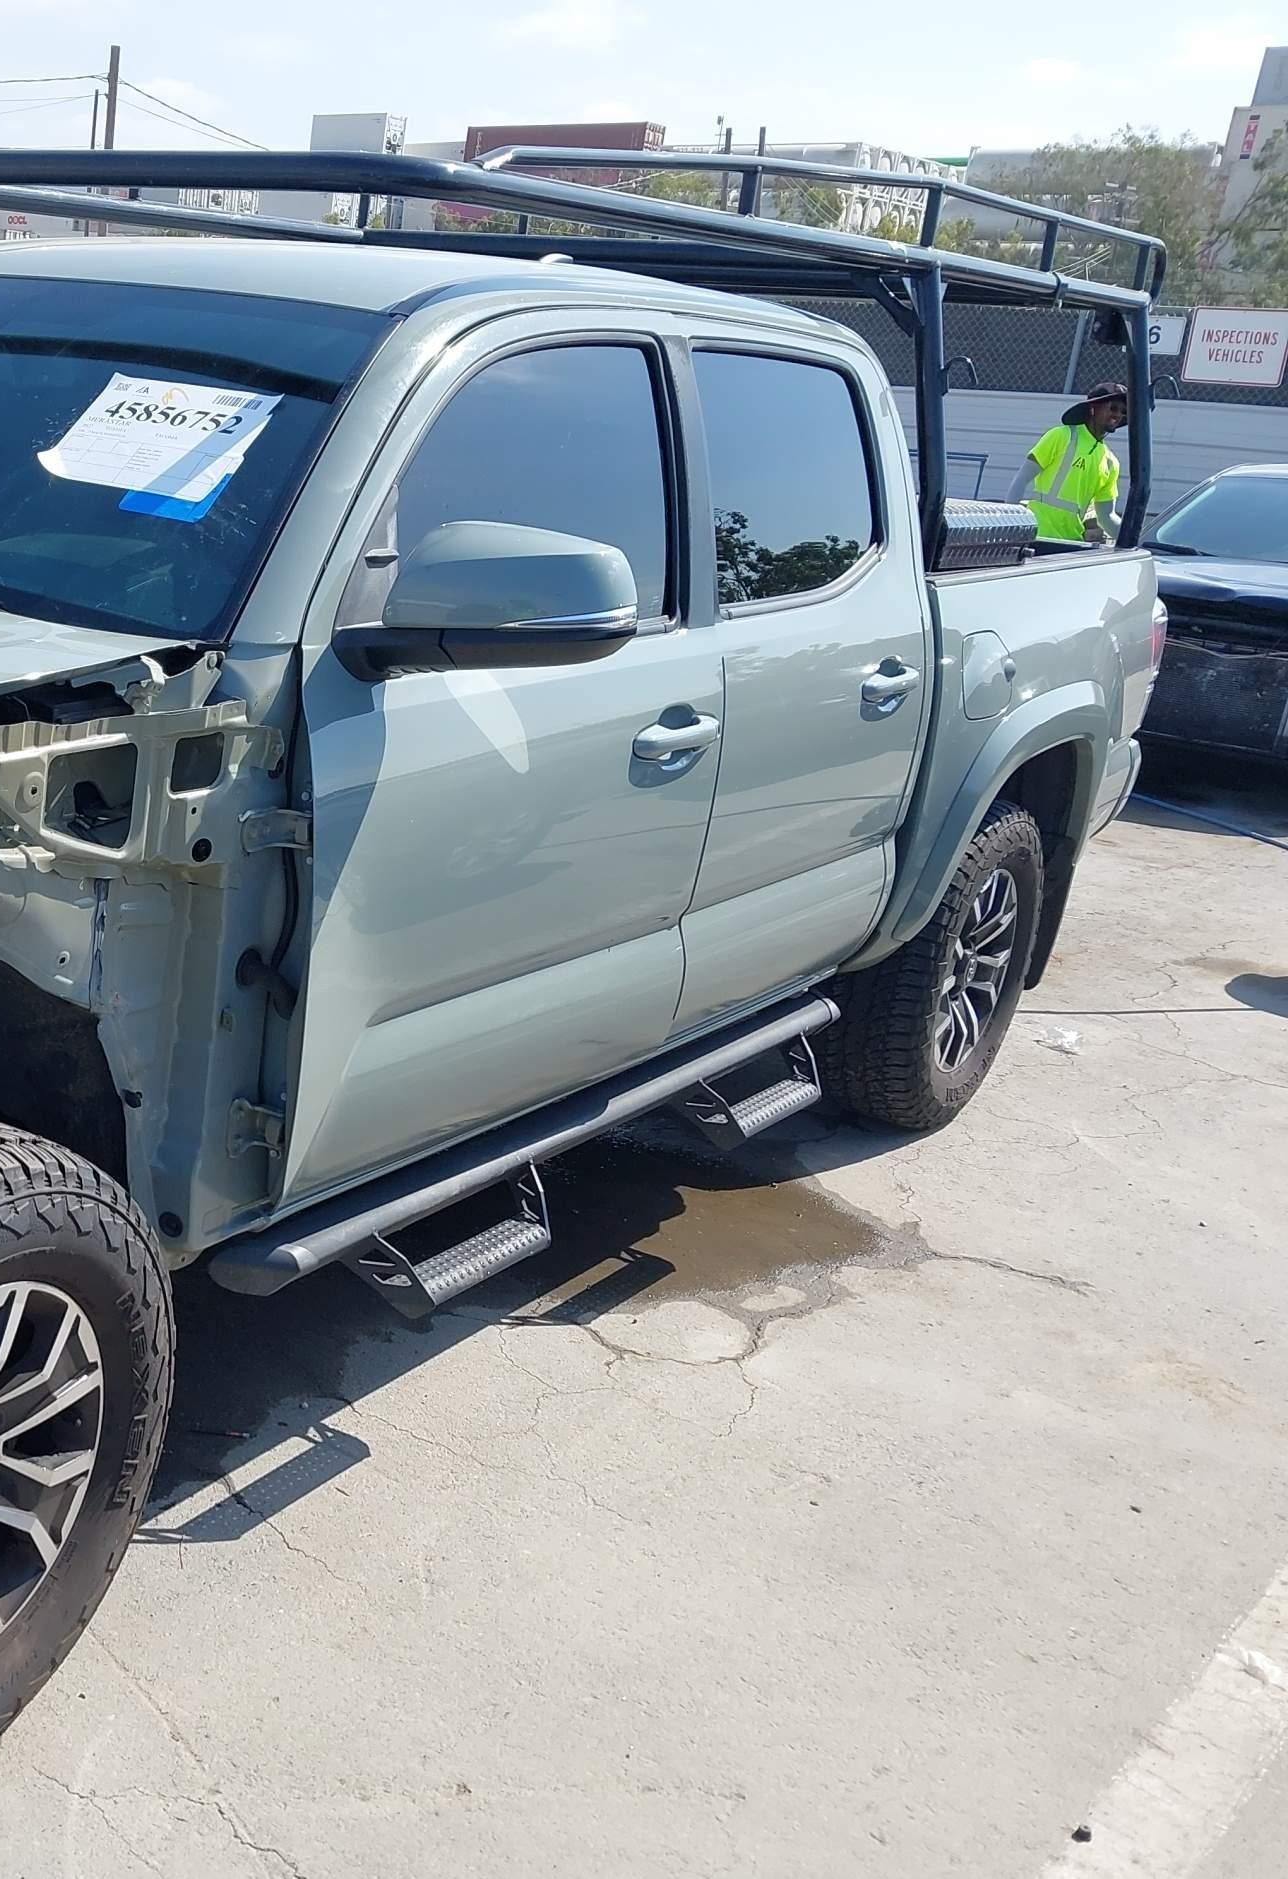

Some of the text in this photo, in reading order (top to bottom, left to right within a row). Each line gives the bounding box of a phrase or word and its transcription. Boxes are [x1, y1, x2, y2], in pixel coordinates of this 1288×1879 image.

[7, 215, 28, 225] OOCL
[1201, 328, 1279, 346] INSPECTIONS
[1207, 347, 1265, 364] VEHICLES
[104, 399, 244, 435] 45856752
[112, 1287, 150, 1505] NEXEN
